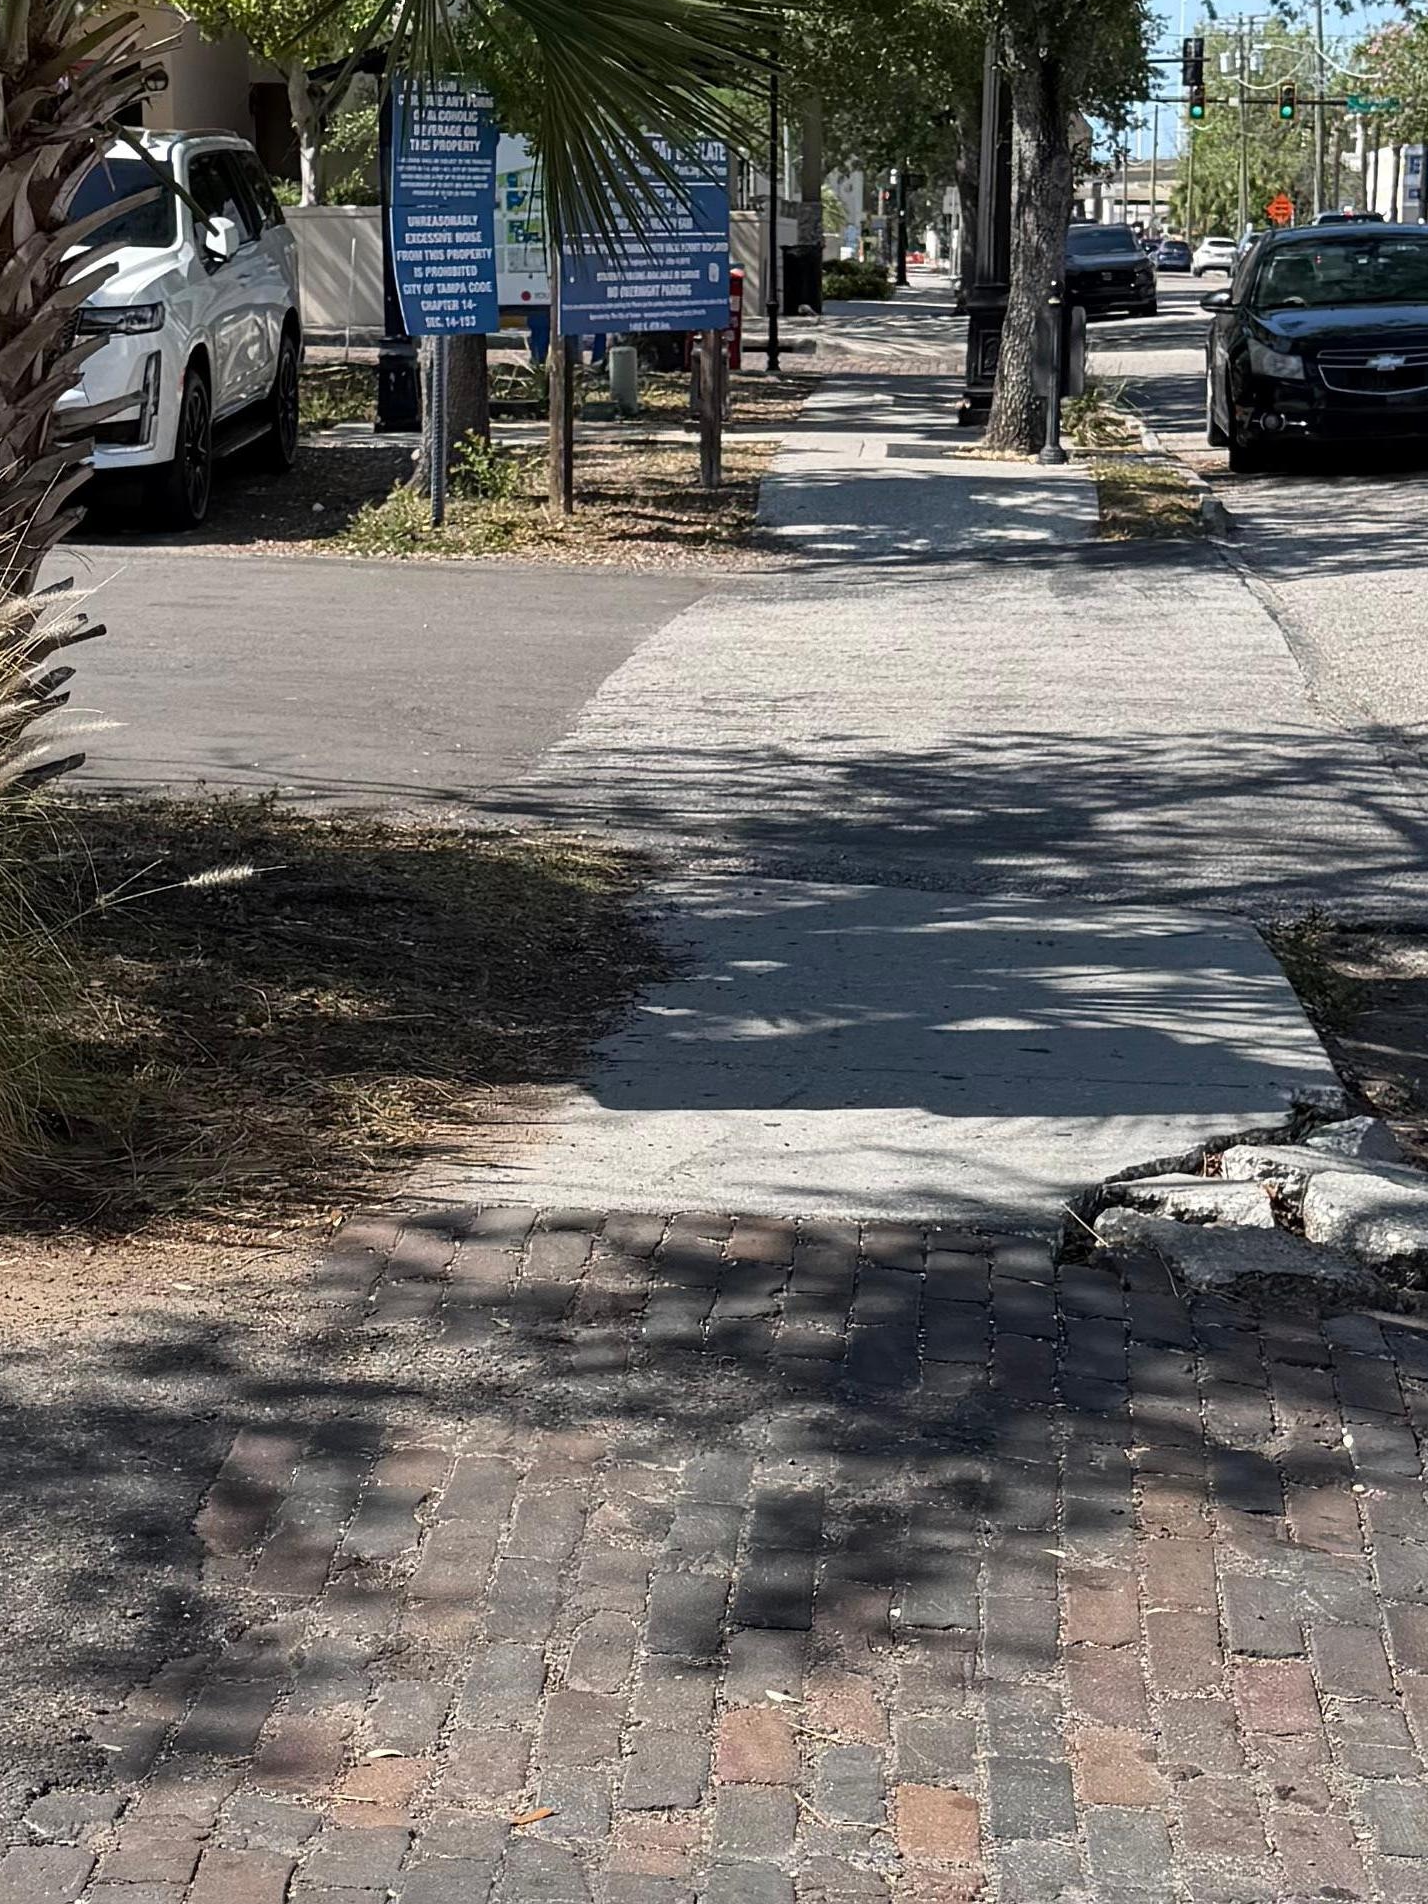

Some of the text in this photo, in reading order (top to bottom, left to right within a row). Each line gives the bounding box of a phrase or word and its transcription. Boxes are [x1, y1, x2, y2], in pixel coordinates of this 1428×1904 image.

[433, 139, 481, 152] PROPERTY
[407, 215, 479, 227] UNREASONABLY
[405, 231, 482, 244] EXCESSIVE NOISE
[396, 248, 492, 261] FROM THIS PROPERTY
[413, 265, 478, 278] IS PROHIBITED
[403, 281, 492, 295] CITY OF TAMPA CODE
[420, 300, 459, 312] CHAPTER
